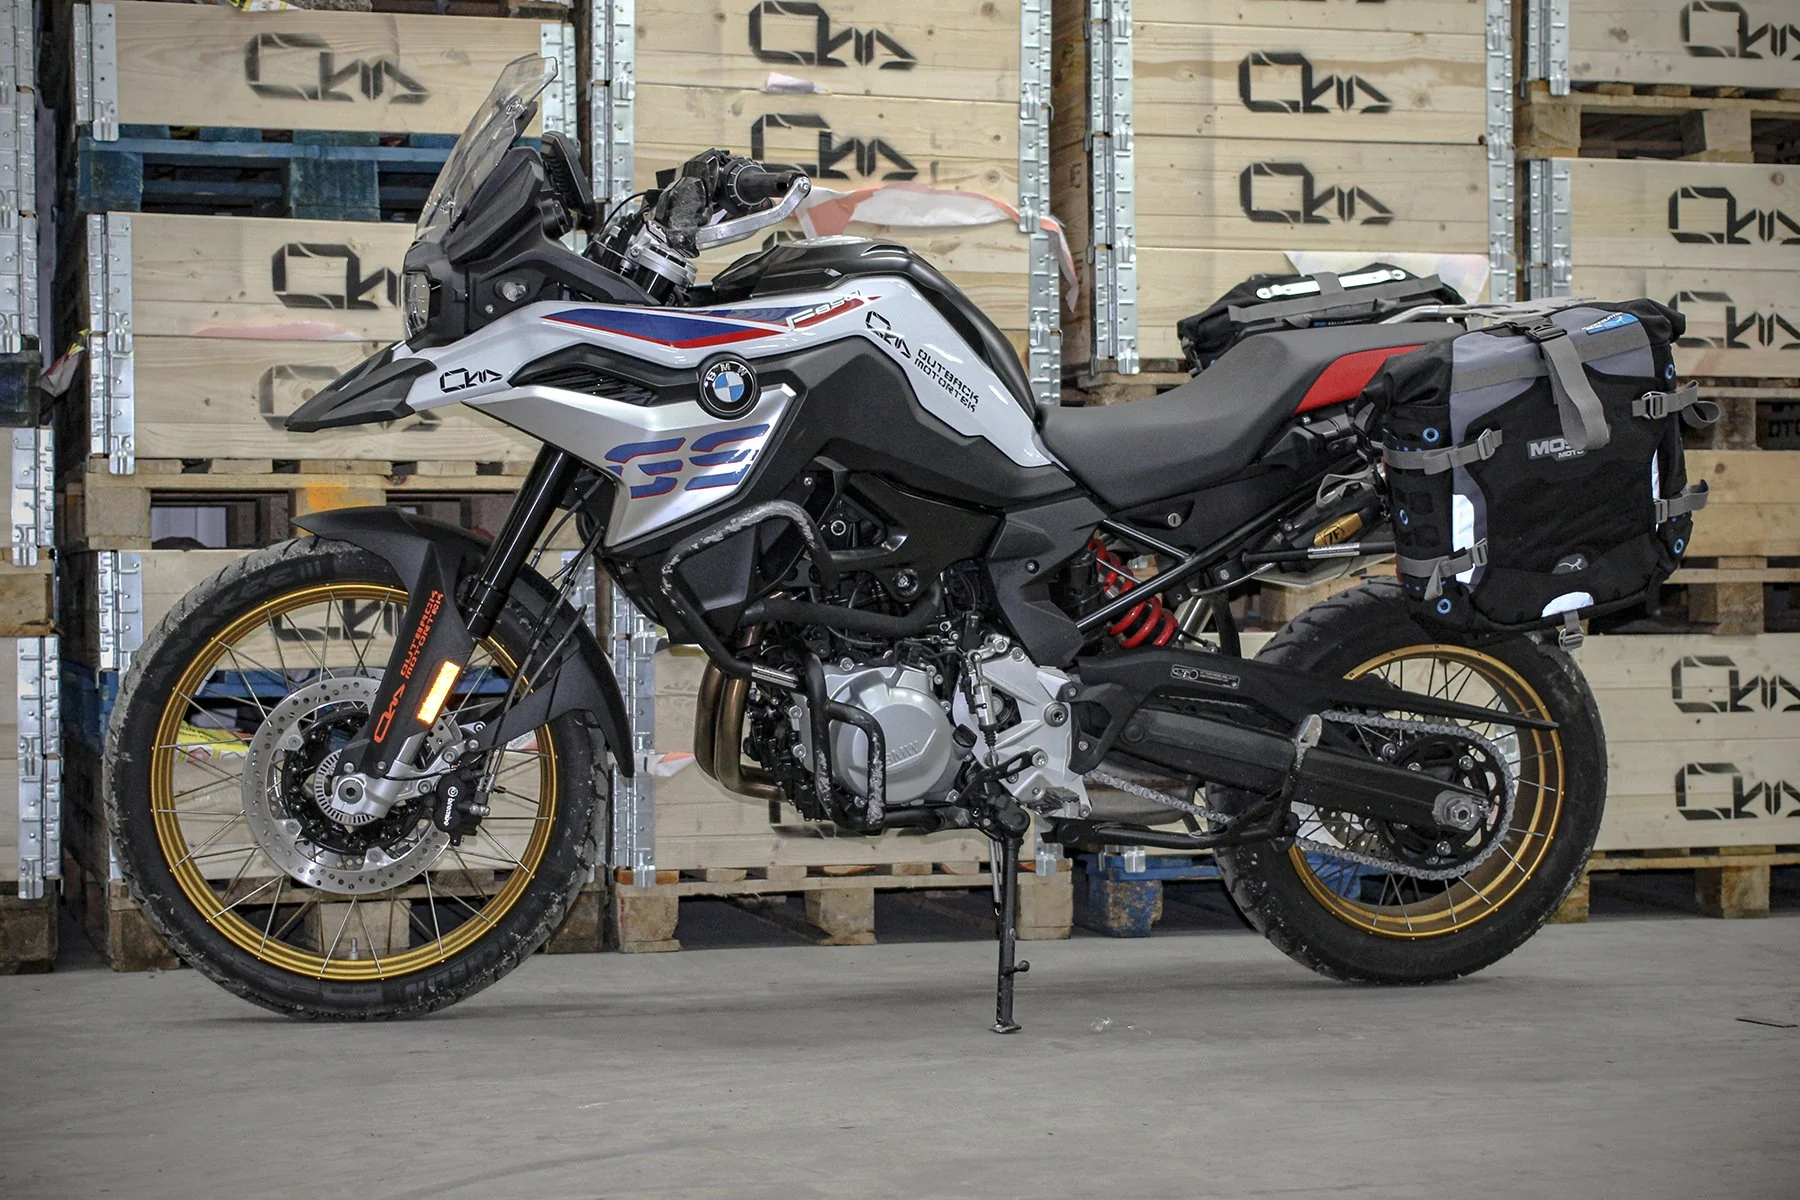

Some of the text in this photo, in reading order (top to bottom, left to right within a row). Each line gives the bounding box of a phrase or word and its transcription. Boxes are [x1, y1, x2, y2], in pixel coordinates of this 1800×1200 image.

[706, 362, 748, 382] BMW
[914, 358, 977, 413] MOTORTEK
[917, 348, 980, 405] OUTBACK
[604, 423, 771, 500] GS
[400, 589, 439, 679] OUTBACK
[404, 592, 445, 681] MOTORTEK
[443, 797, 456, 827] brembo
